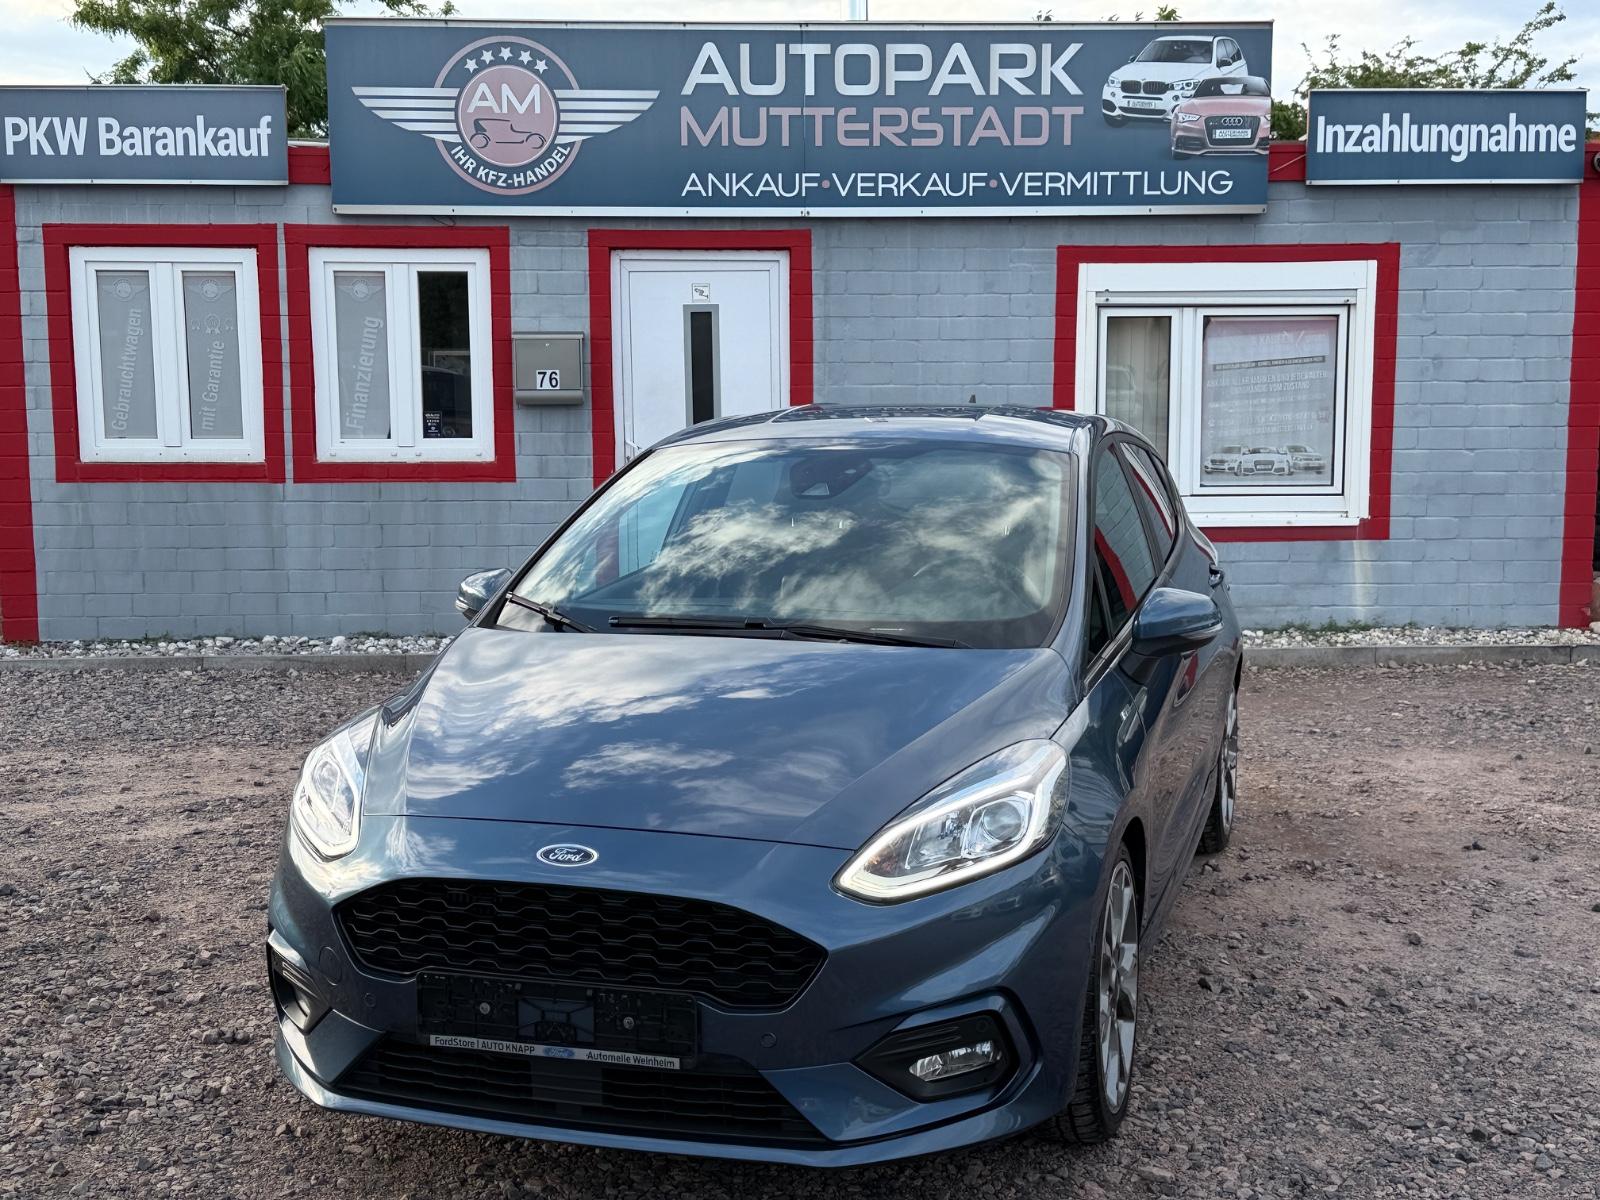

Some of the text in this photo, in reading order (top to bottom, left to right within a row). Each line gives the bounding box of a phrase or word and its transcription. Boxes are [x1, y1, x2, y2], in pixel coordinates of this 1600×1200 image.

[681, 41, 1084, 97] AUTOPARK
[466, 82, 541, 114] AM
[4, 115, 272, 157] PKW Barankauf
[680, 106, 1084, 148] MUTTERSTADT
[1316, 112, 1577, 163] Inzahlungnahme
[450, 145, 571, 188] IHR KFZ-HANDEL
[681, 170, 1234, 198] ANKAUF VERKAUF VERMITTLUNG
[112, 308, 144, 431] Gebrauchtwagen
[198, 341, 225, 431] mit Garantie
[345, 316, 384, 428] Finanzierung
[537, 371, 559, 389] 76
[548, 847, 585, 862] Ford
[434, 1036, 476, 1048] FordStore
[481, 1040, 505, 1051] AUTO
[505, 1043, 536, 1055] KNAPP
